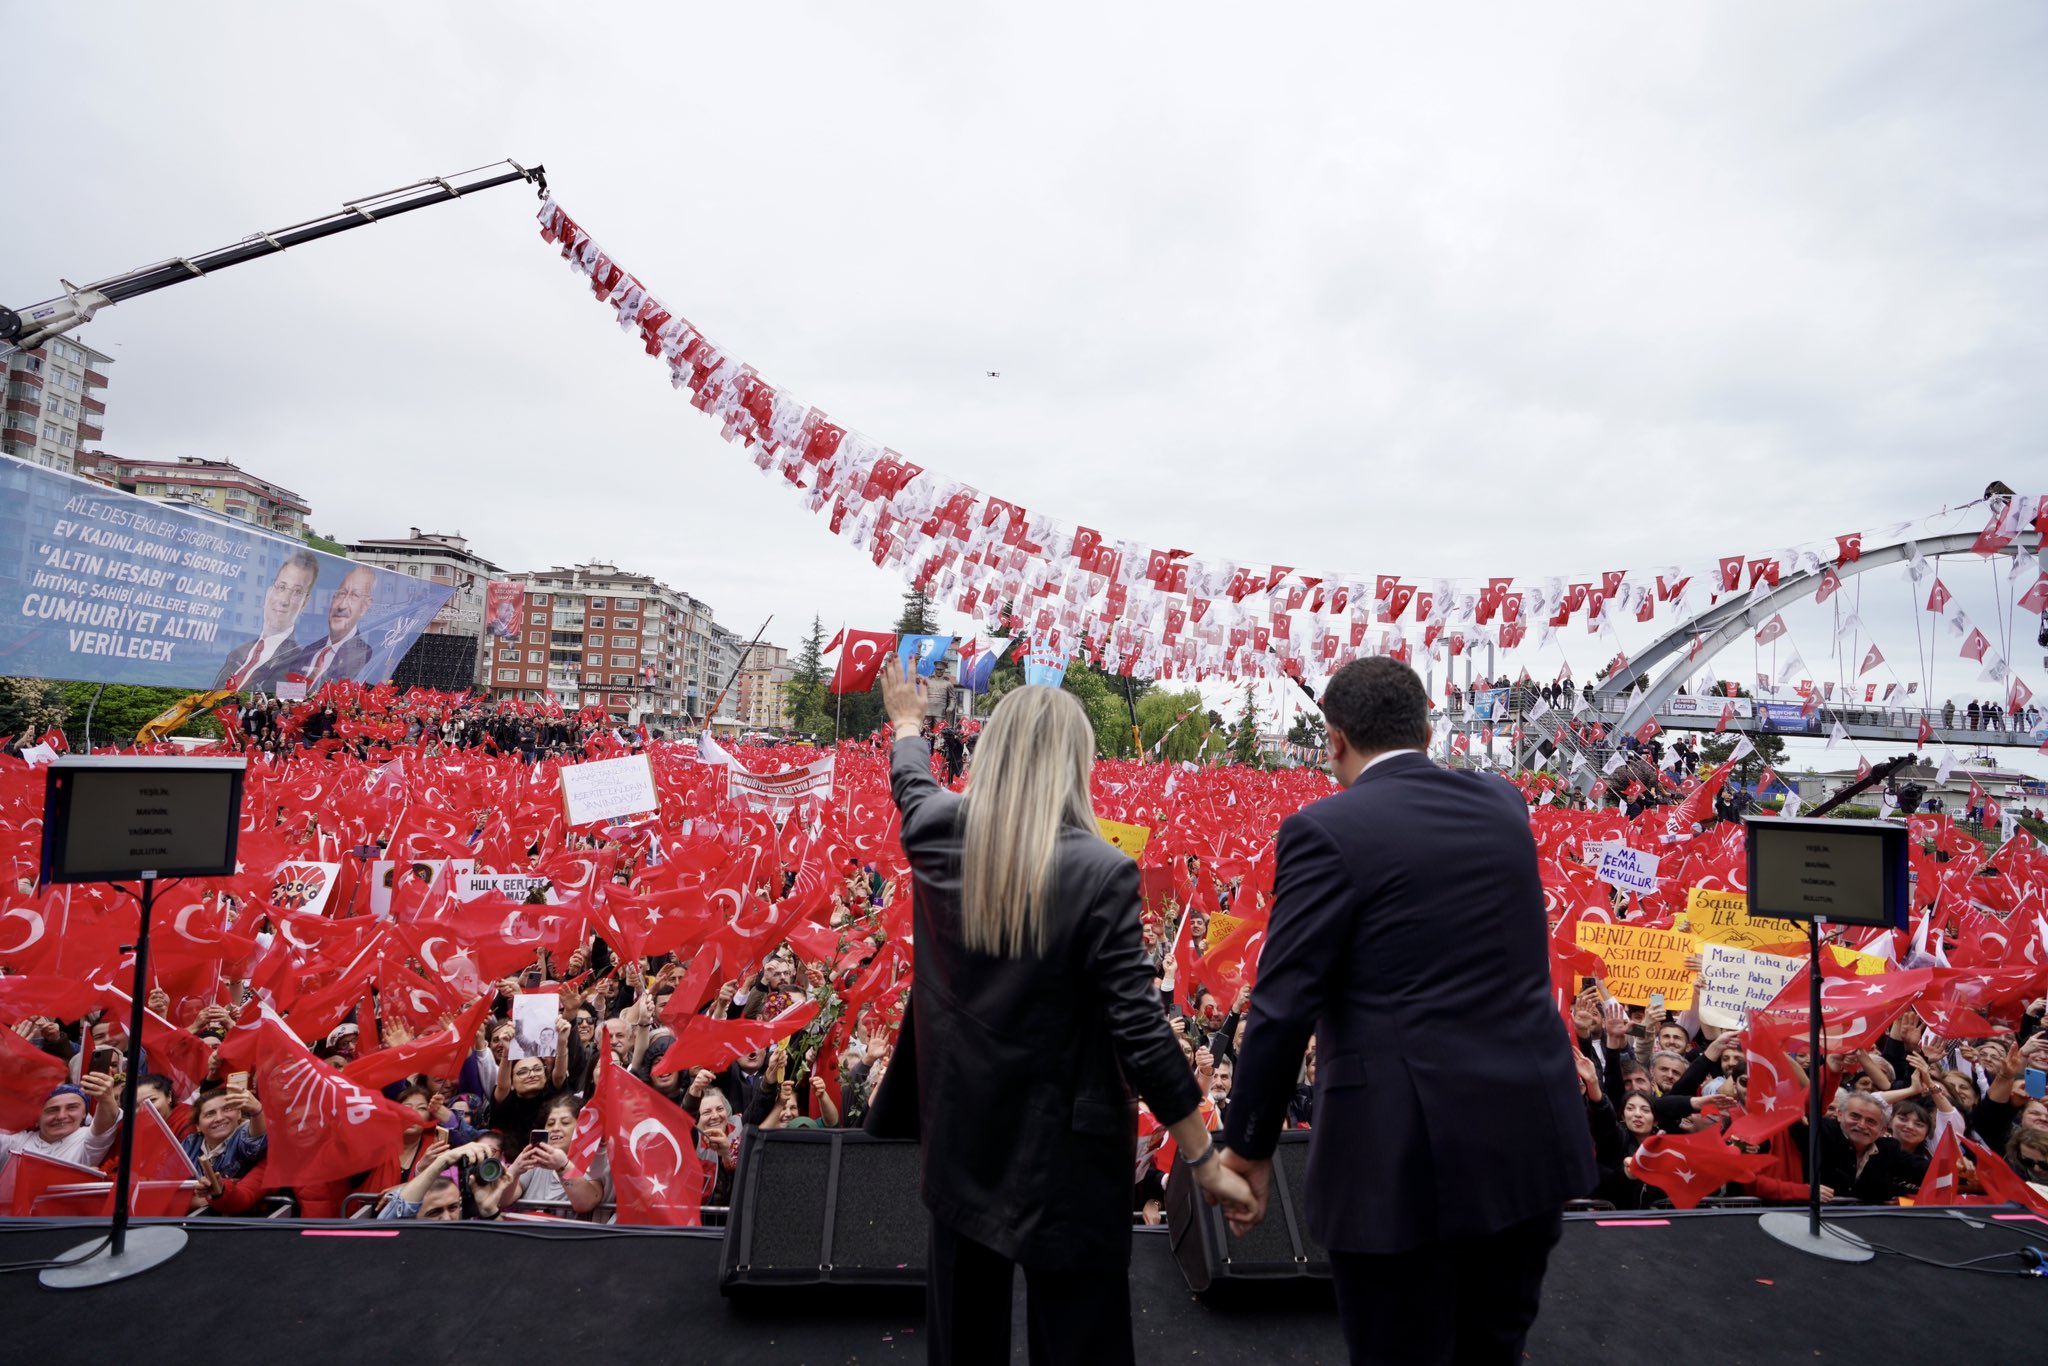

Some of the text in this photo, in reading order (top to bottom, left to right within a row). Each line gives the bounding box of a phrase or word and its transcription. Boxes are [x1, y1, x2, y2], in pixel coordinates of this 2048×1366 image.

[64, 494, 252, 559] AİLE DESTEKLERİ SİGORTASI İLE
[53, 519, 242, 578] EV KADINLARININ SİGORTASI
[32, 569, 225, 619] İHTİYAÇ SAHİBİ AİLELERE HER AY
[175, 576, 232, 601] OLACAK
[22, 593, 219, 642] CUMHURİYET ALTINI
[69, 629, 176, 662] VERİLECEK
[1617, 849, 1636, 862] MA
[470, 879, 499, 891] HULK
[1696, 890, 1744, 910] Sana
[1580, 925, 1695, 954] DENİZ OLDUK
[1645, 967, 1692, 984] OLDUK
[1704, 964, 1740, 980] Gübre
